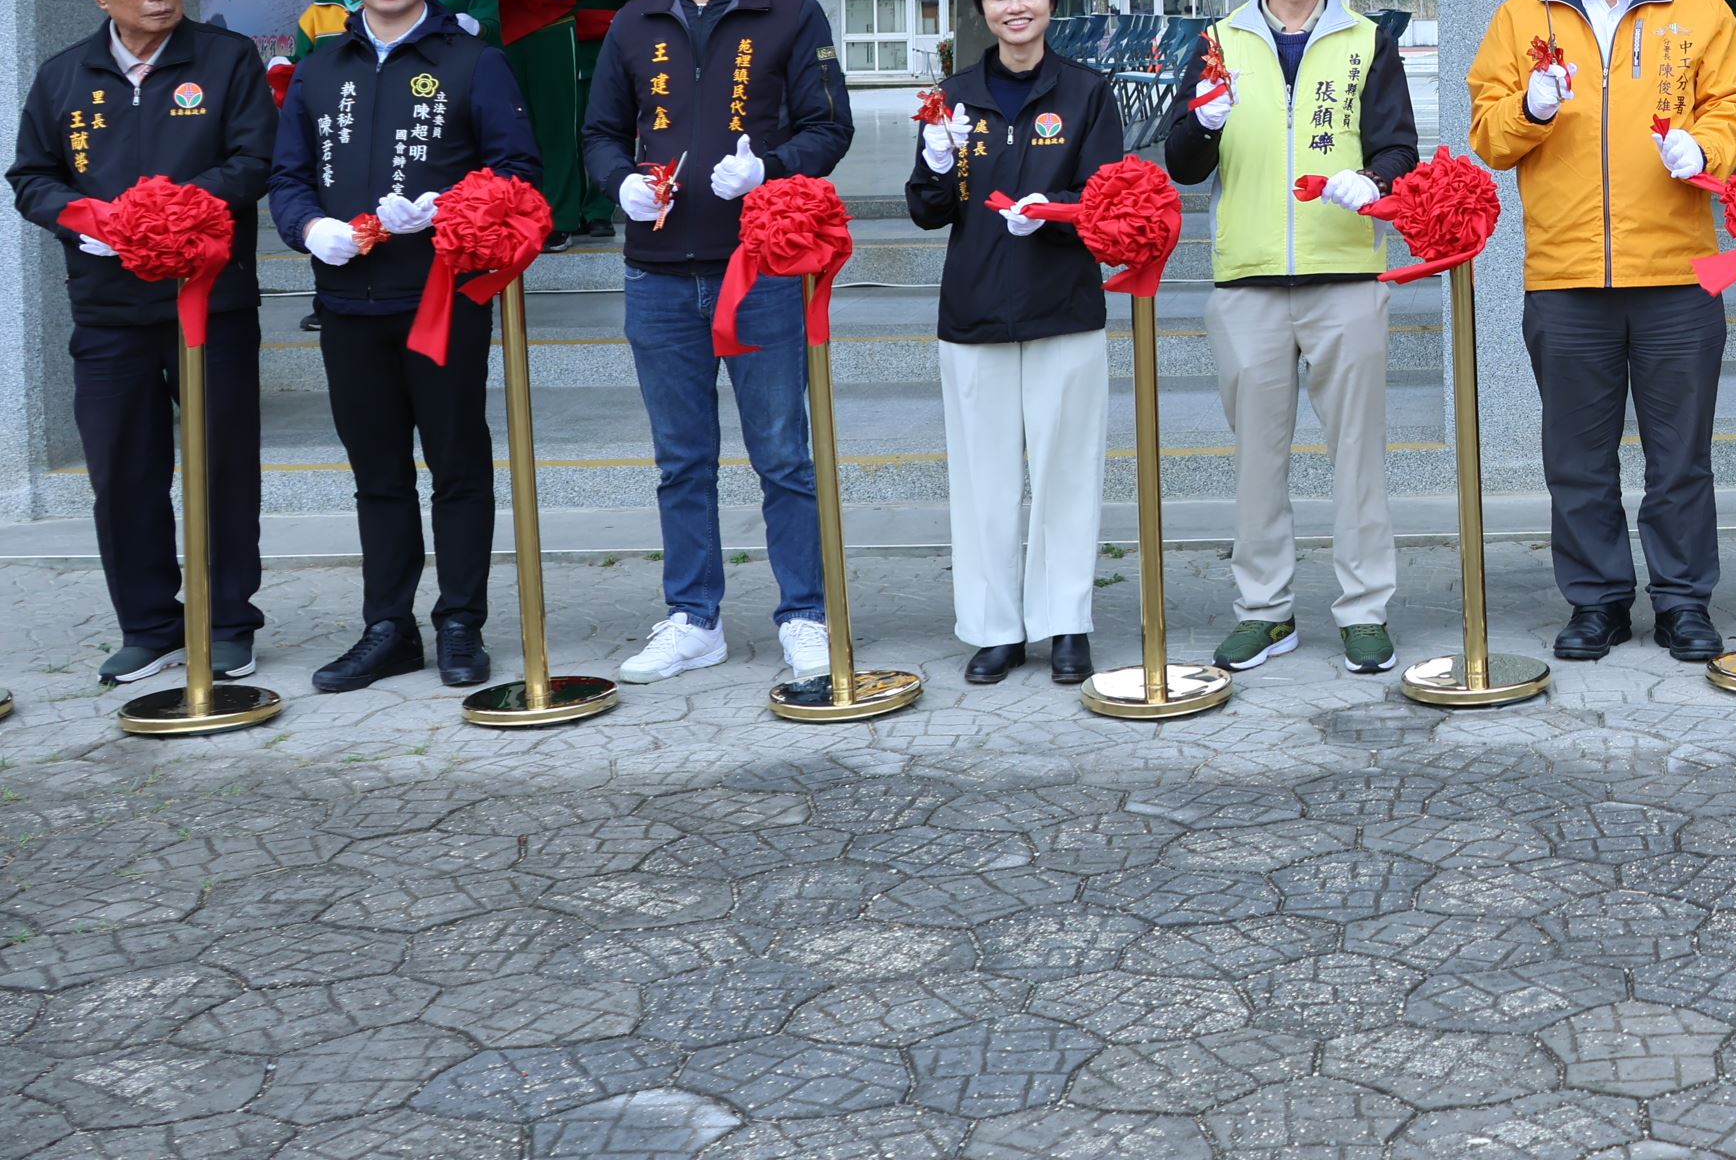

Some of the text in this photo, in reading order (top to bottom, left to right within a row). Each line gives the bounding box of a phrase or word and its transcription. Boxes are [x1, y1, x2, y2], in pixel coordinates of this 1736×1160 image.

[91, 89, 108, 130] 里長
[650, 42, 671, 131] 王建鑫
[727, 39, 754, 133] 苑裡鎮民代表
[1341, 53, 1362, 130] 苗栗縣議員
[1656, 64, 1675, 113] 陳俊雄
[1673, 40, 1694, 116] 中工分署
[336, 81, 357, 144] 執行秘書
[408, 102, 431, 162] 陳超明
[431, 91, 449, 139] 立法委員
[972, 119, 990, 157] 處長
[391, 129, 408, 196] 國會辦公室
